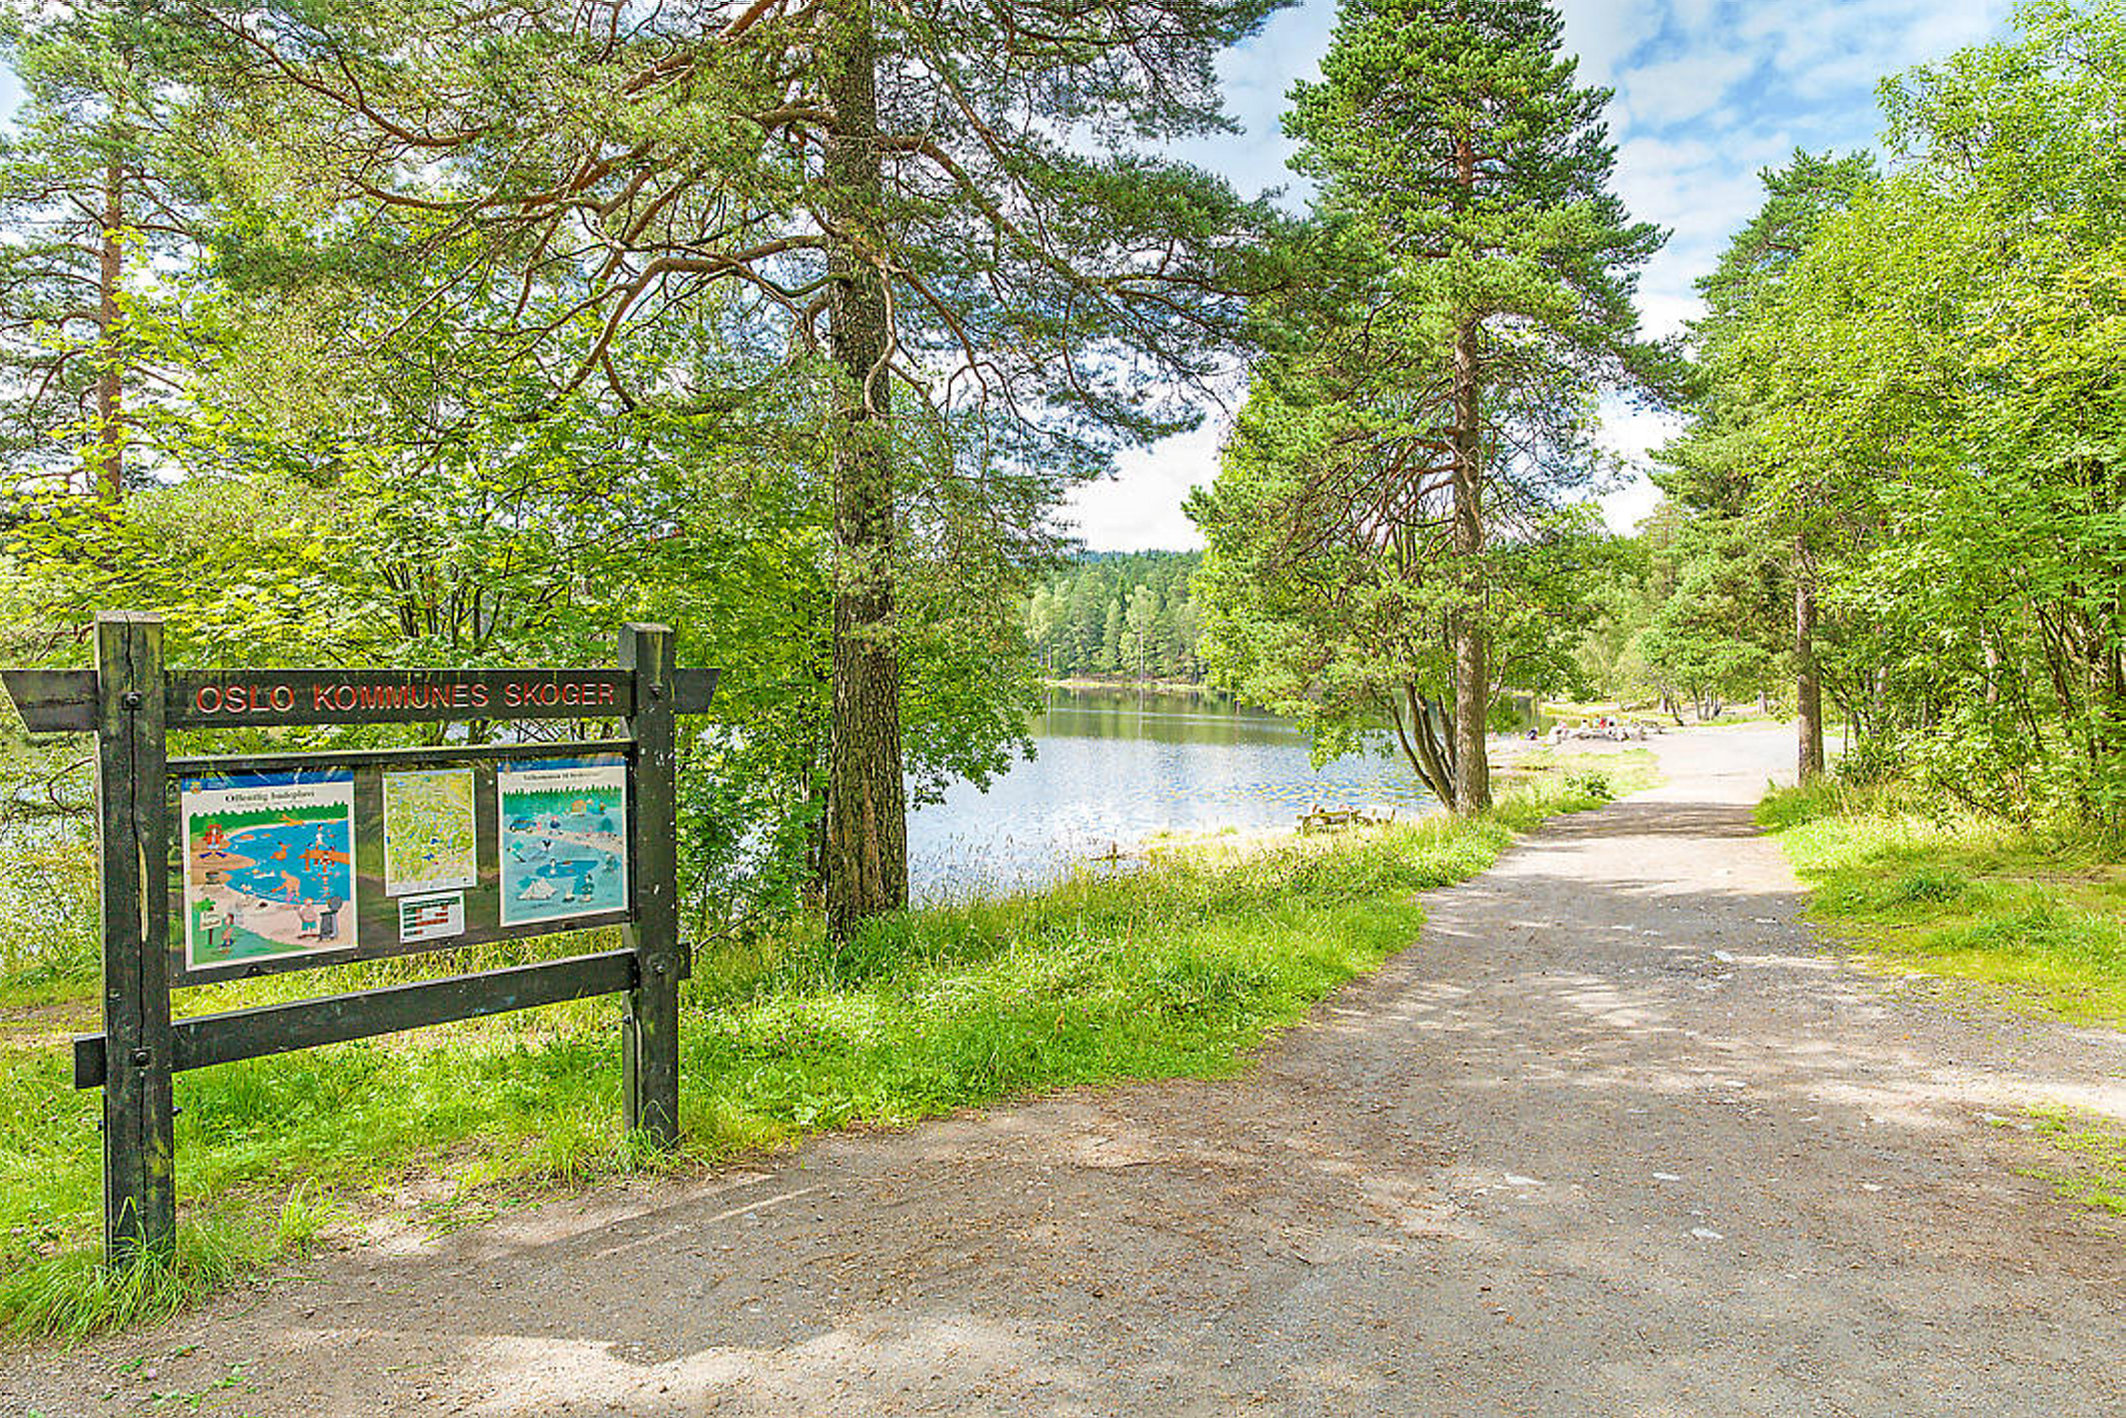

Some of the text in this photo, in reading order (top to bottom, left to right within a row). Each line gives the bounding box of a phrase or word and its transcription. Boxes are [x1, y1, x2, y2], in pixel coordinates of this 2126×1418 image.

[196, 682, 614, 714] OSLO KOMMUNES SKOGER
